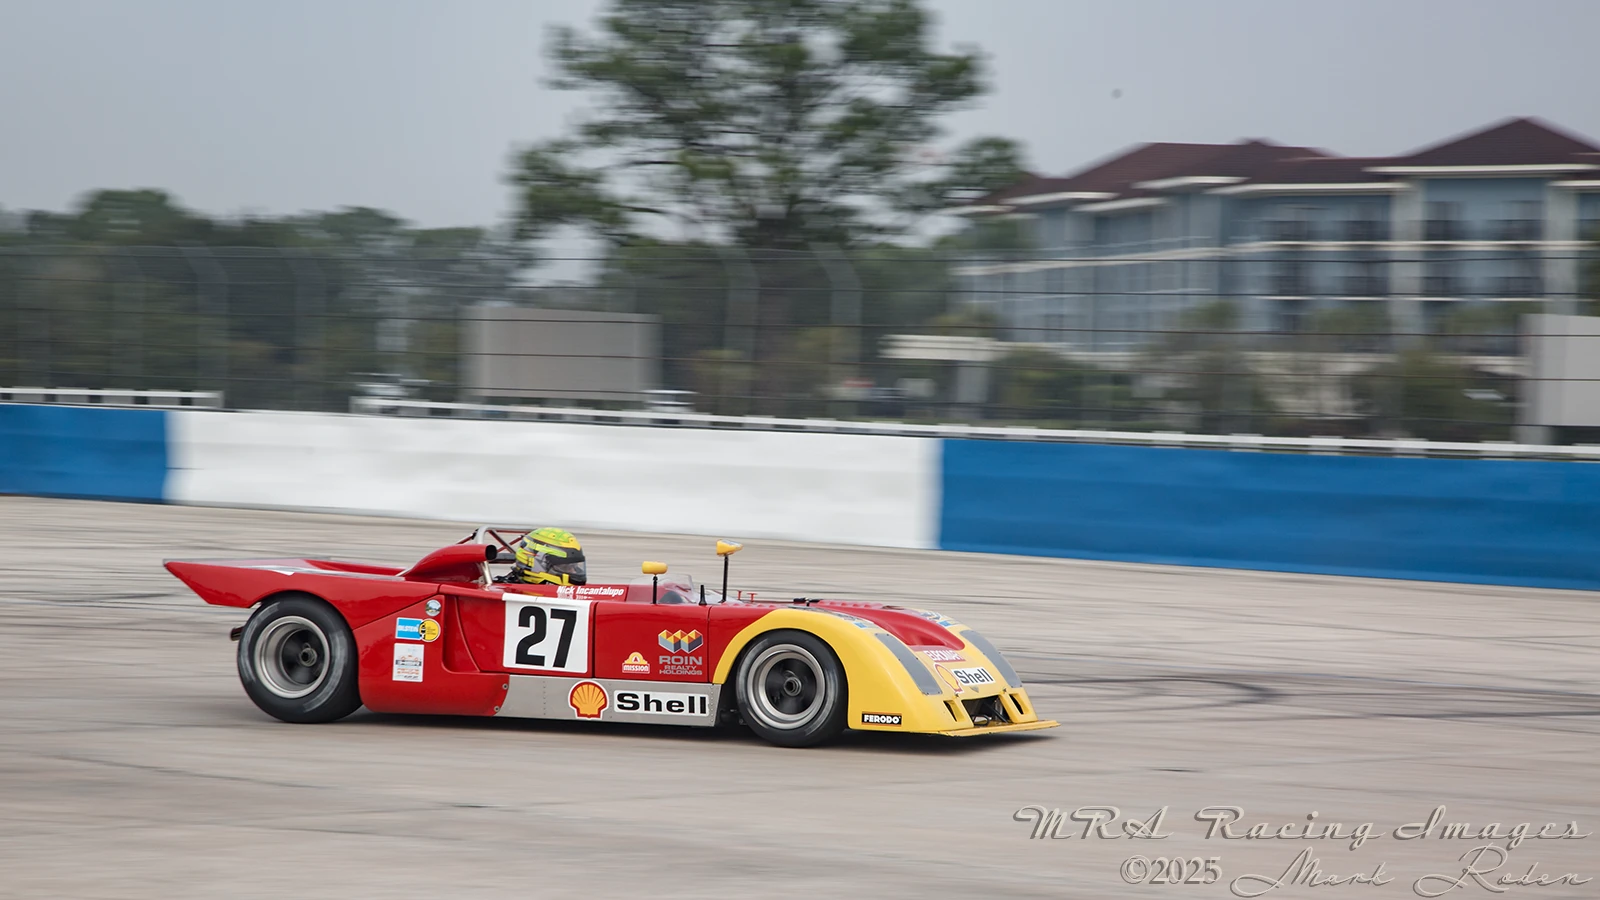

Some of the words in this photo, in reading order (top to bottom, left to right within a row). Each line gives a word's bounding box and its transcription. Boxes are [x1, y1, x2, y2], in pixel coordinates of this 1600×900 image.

[556, 585, 574, 594] Nick
[576, 586, 624, 597] Incantalupo
[515, 606, 577, 669] 27
[659, 655, 703, 665] ROIN
[953, 668, 994, 684] Shell
[616, 692, 707, 714] Shell
[864, 714, 900, 724] FERODO
